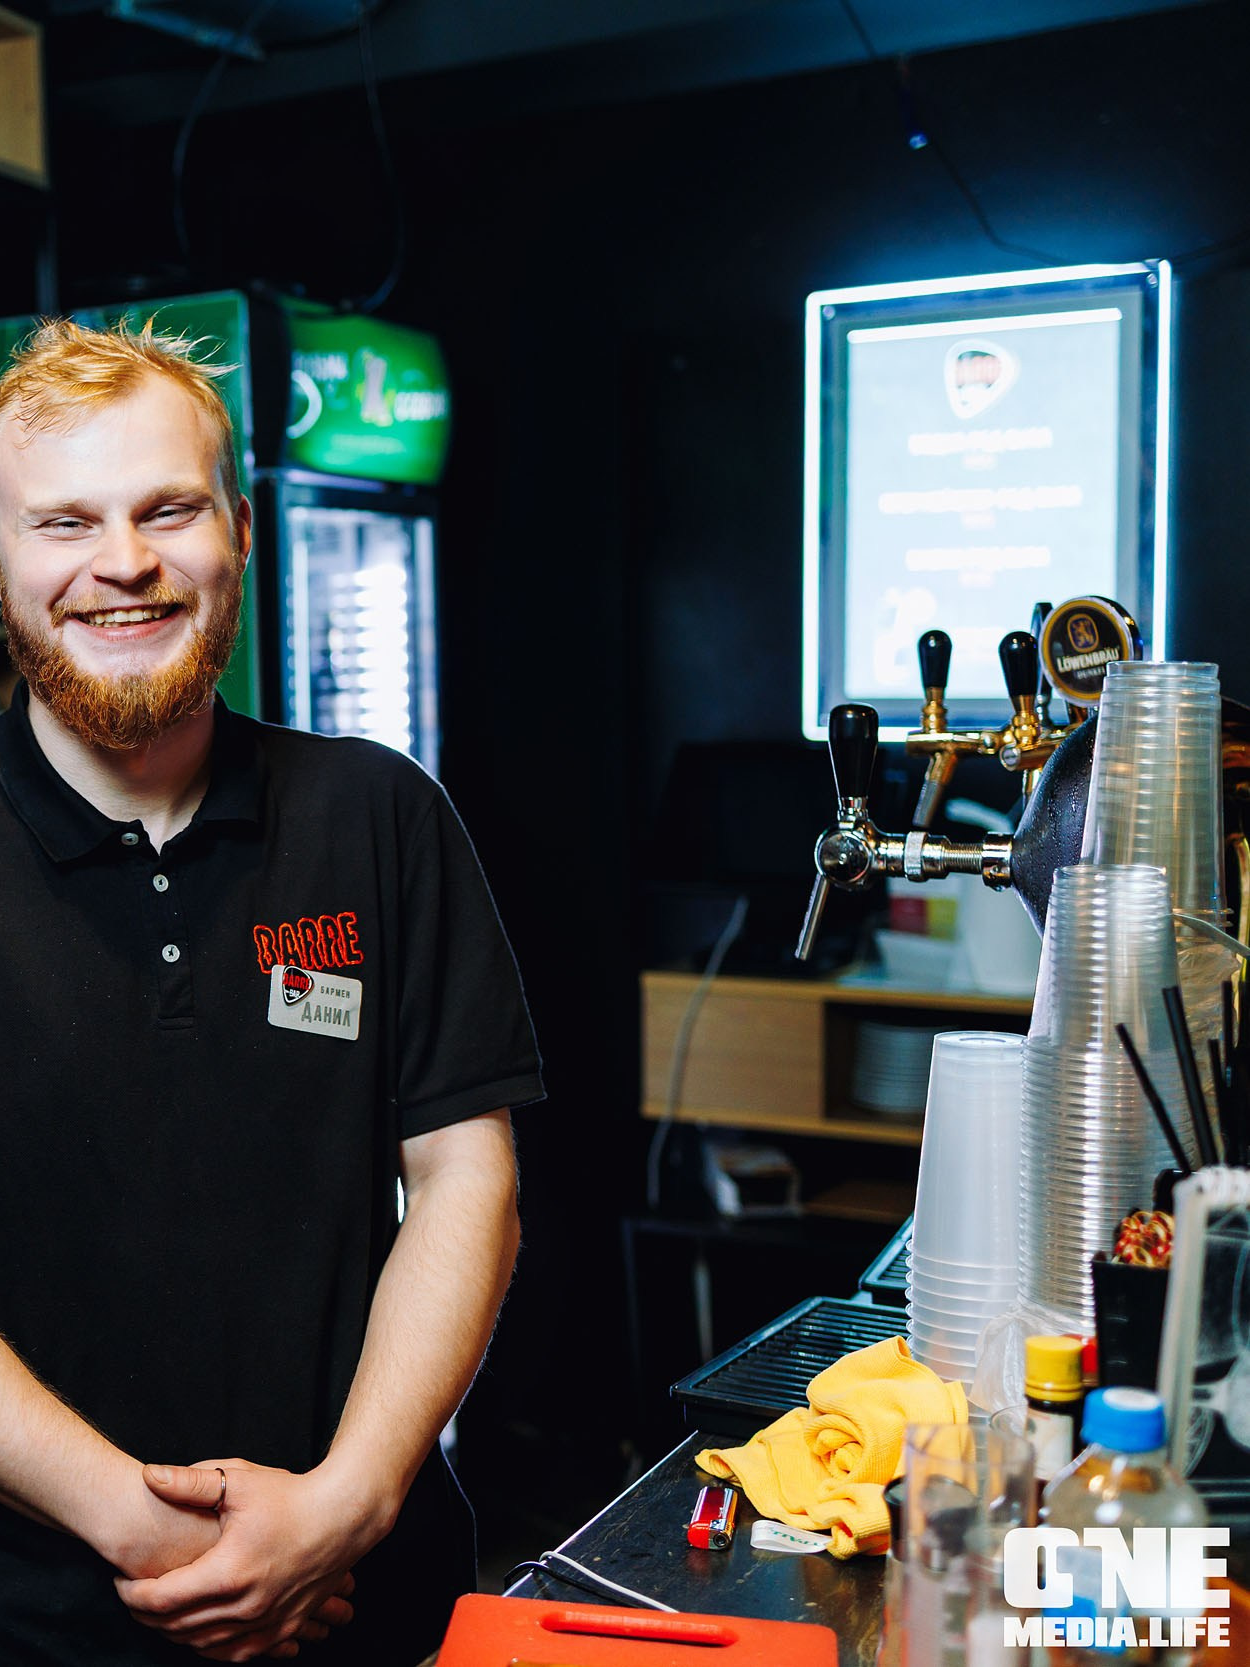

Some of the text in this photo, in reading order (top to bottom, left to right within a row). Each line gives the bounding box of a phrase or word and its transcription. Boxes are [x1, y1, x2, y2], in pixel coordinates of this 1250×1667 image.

[253, 911, 365, 975] BARRE
[320, 985, 351, 999] БАРМЕН
[301, 1001, 351, 1027] ДАНИЛ
